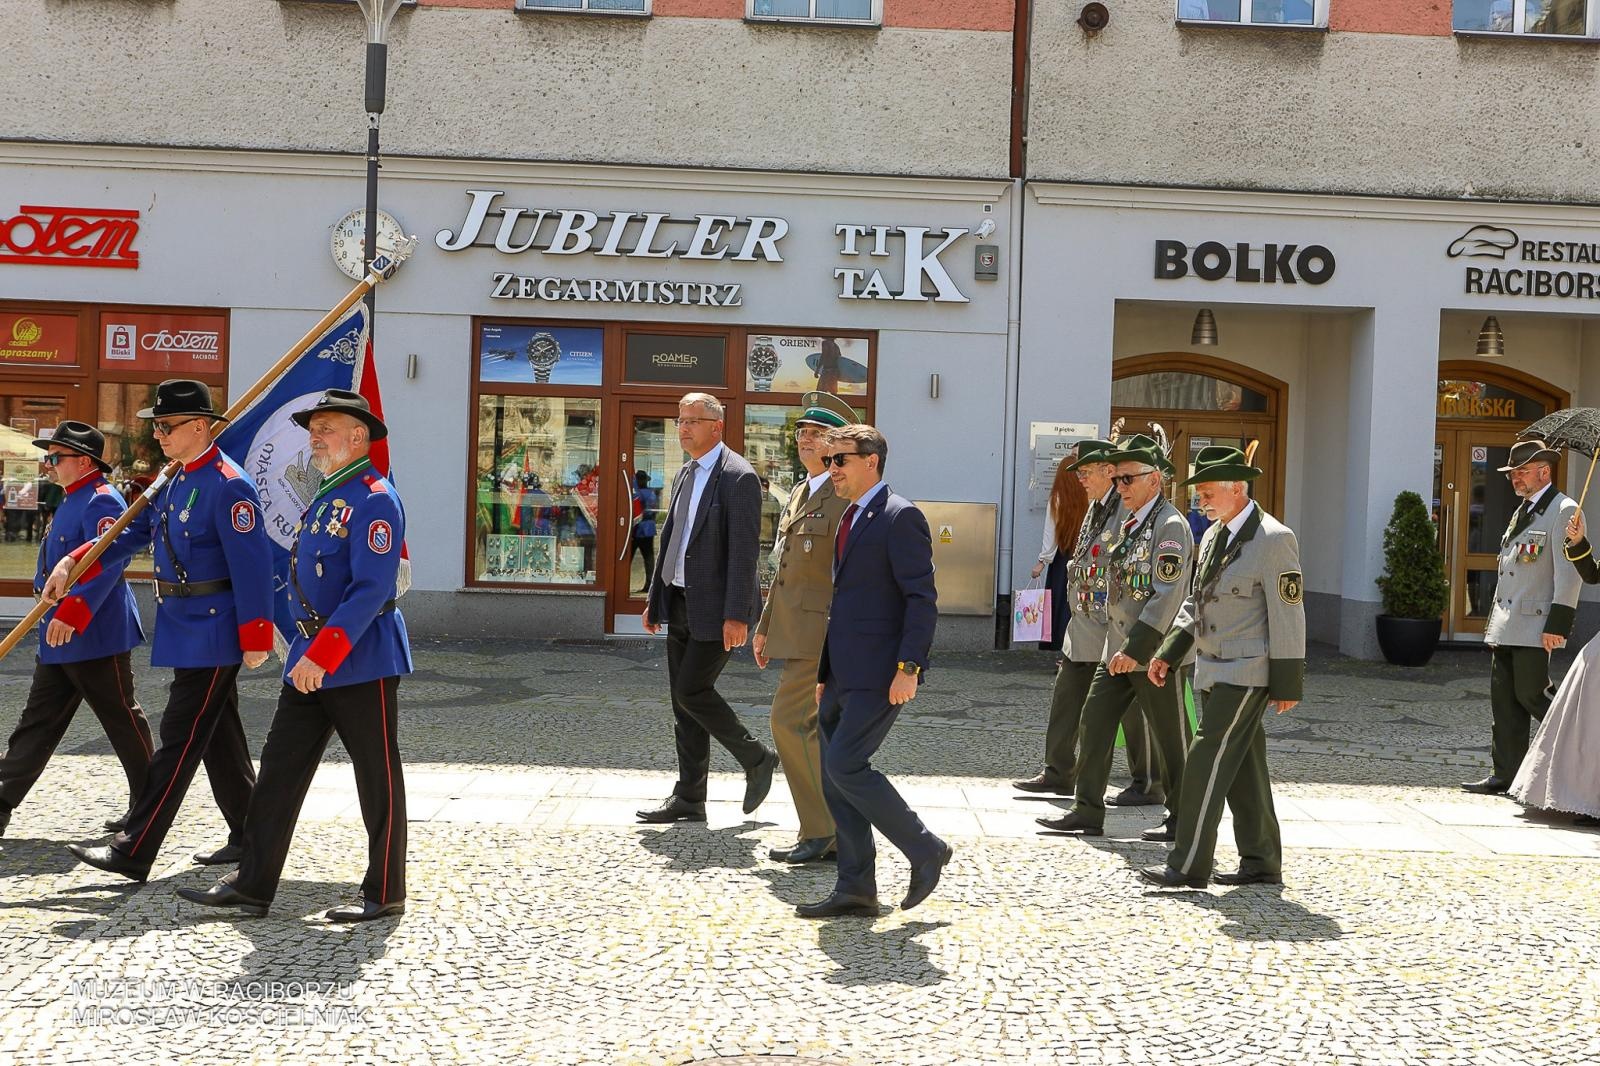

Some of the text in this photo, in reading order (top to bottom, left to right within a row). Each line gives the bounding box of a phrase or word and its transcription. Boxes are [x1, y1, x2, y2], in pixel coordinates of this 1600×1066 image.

[434, 189, 790, 262] JUBILER
[1154, 239, 1337, 285] BOLKO
[489, 272, 743, 307] ZEGARMISTRZ
[1465, 266, 1600, 299] RACIBOR
[652, 352, 698, 366] ROAMER
[779, 338, 817, 348] ORIENT
